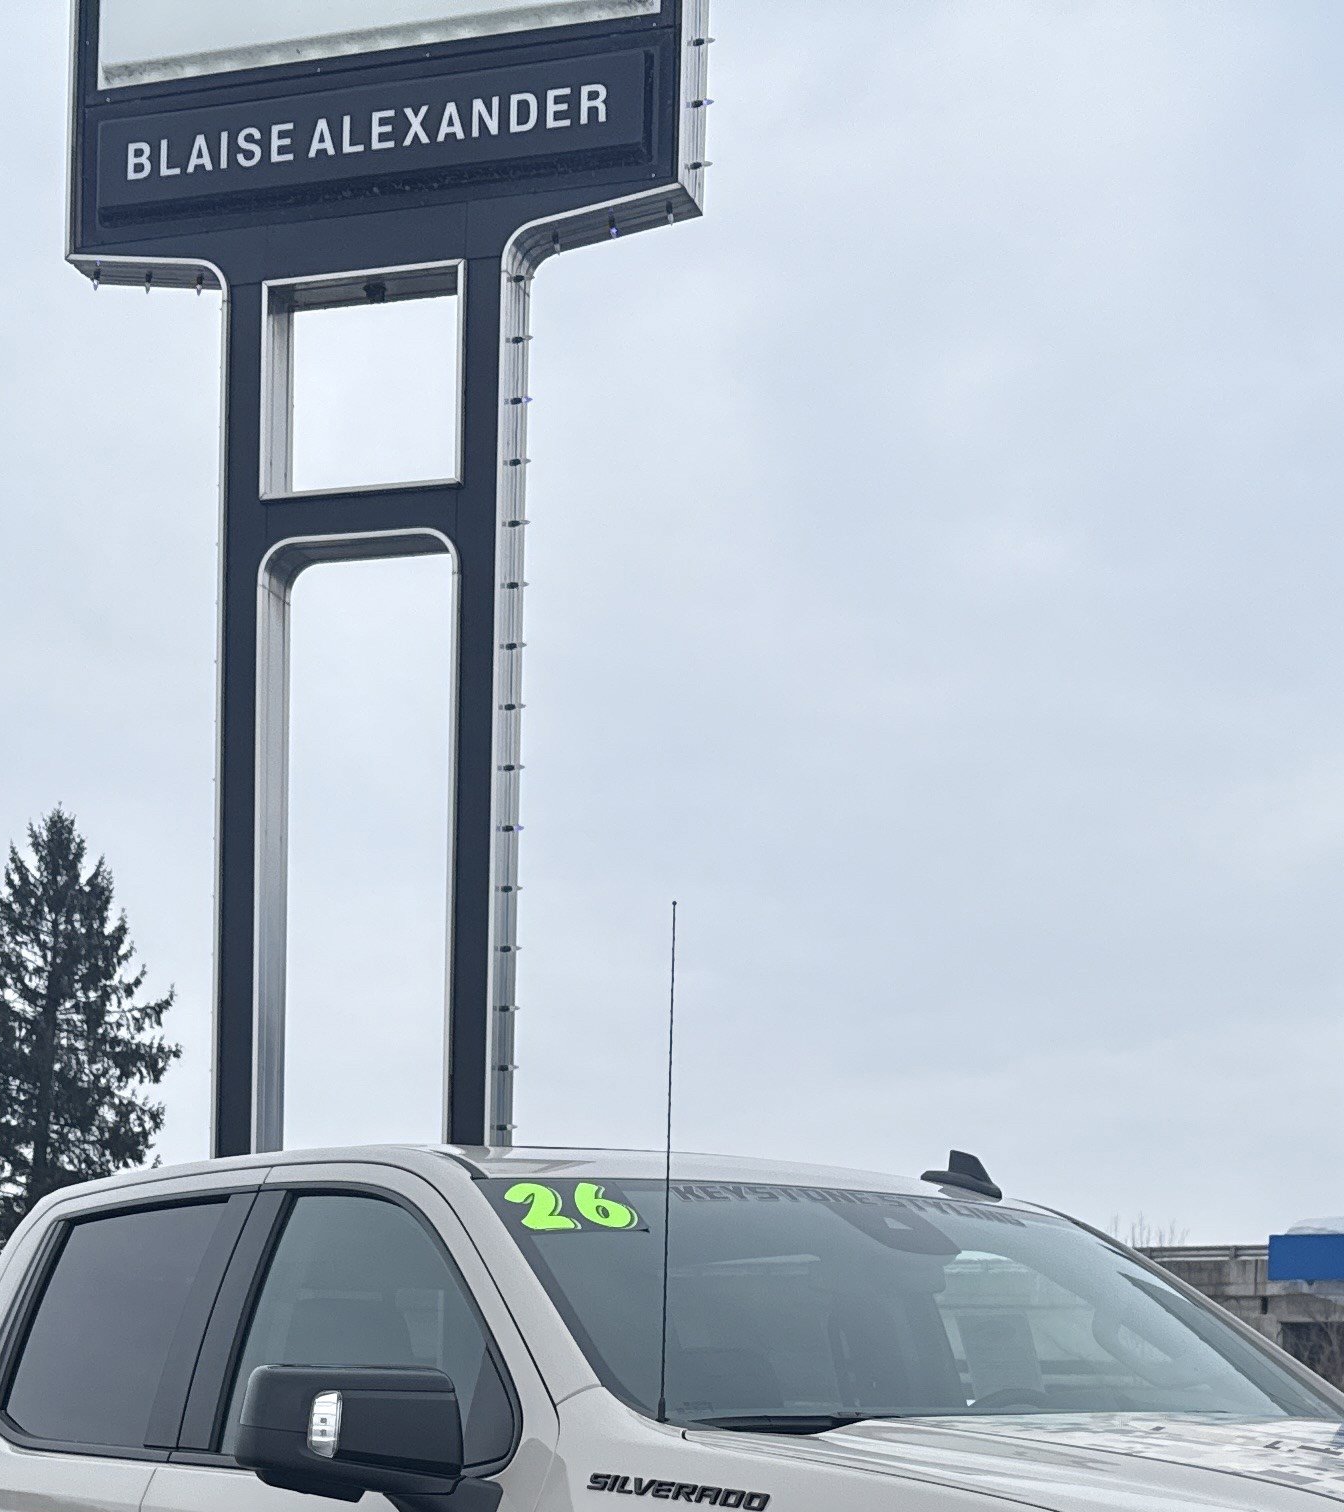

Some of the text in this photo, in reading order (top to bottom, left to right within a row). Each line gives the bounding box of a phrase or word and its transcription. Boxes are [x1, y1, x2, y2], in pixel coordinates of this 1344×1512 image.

[126, 83, 609, 181] BLAISE ALEXANDER
[504, 1182, 638, 1231] 26
[670, 1183, 1027, 1229] KEYSTONE STYLING
[587, 1472, 771, 1512] SILVERADO
